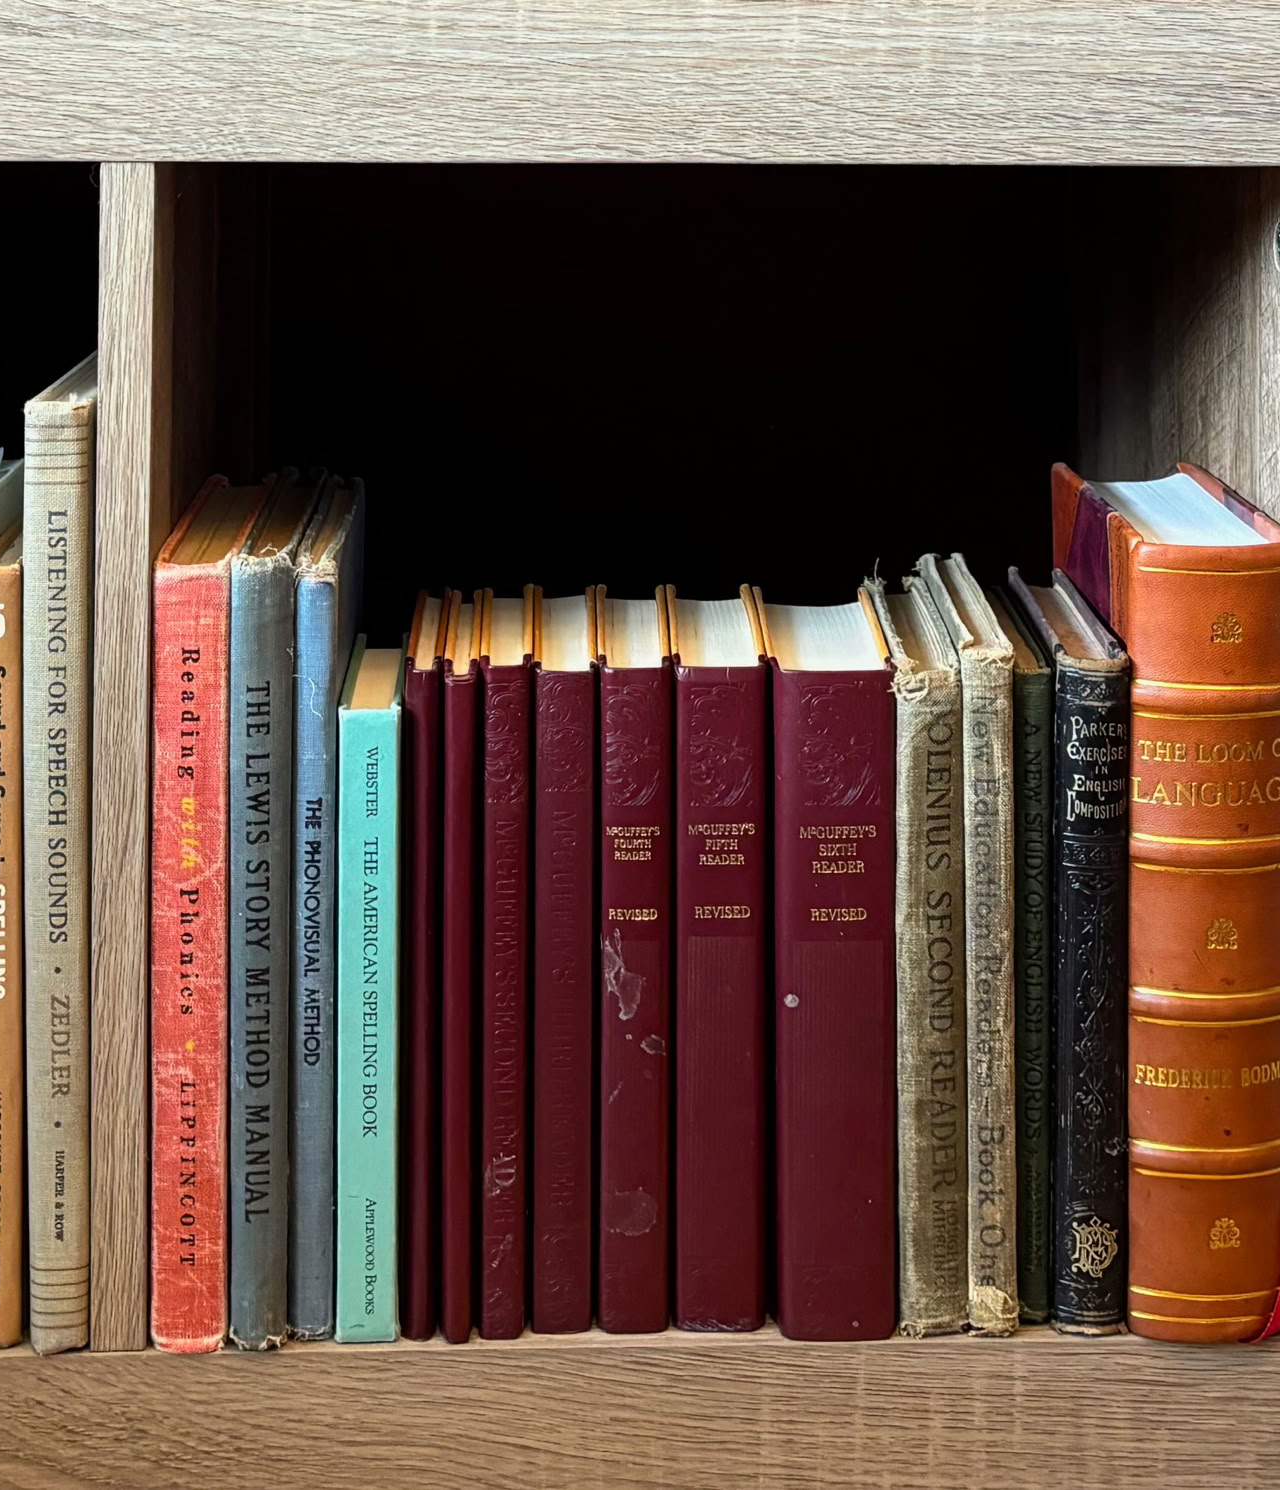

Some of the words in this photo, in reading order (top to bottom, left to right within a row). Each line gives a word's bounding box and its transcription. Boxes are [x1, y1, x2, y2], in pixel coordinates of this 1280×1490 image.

[48, 509, 69, 653] LISTENING
[48, 665, 68, 717] FOR
[177, 647, 200, 779] Reading
[245, 680, 271, 738] THE
[48, 728, 69, 826] SPEECH
[365, 746, 379, 818] WEBSTER
[1138, 740, 1186, 762] THE
[1196, 739, 1264, 763] LOOM
[245, 754, 271, 846] LEWIS
[305, 796, 322, 830] THE
[364, 837, 378, 876] THE
[699, 854, 745, 866] READER
[705, 839, 738, 851] FIFTH
[812, 861, 865, 874] READER
[818, 844, 857, 857] SIXTH
[48, 838, 69, 944] SOUNDS
[245, 860, 271, 953] STORY
[304, 839, 321, 977] PHONOVISUAL
[363, 881, 378, 984] AMERICAN
[608, 908, 657, 921] REVISED
[694, 906, 751, 919] REVISED
[811, 908, 867, 922] REVISED
[179, 888, 200, 1015] Phonics
[50, 994, 72, 1099] ZEDLER
[245, 967, 271, 1089] METHOD
[304, 988, 321, 1067] METHOD
[362, 990, 378, 1078] SPELLING
[362, 1084, 378, 1138] BOOK
[930, 1049, 957, 1193] READER
[55, 1150, 65, 1198] HARPER
[179, 1081, 197, 1266] LIPPINCOTT
[244, 1105, 271, 1223] MANUAL
[975, 1122, 1004, 1212] Book
